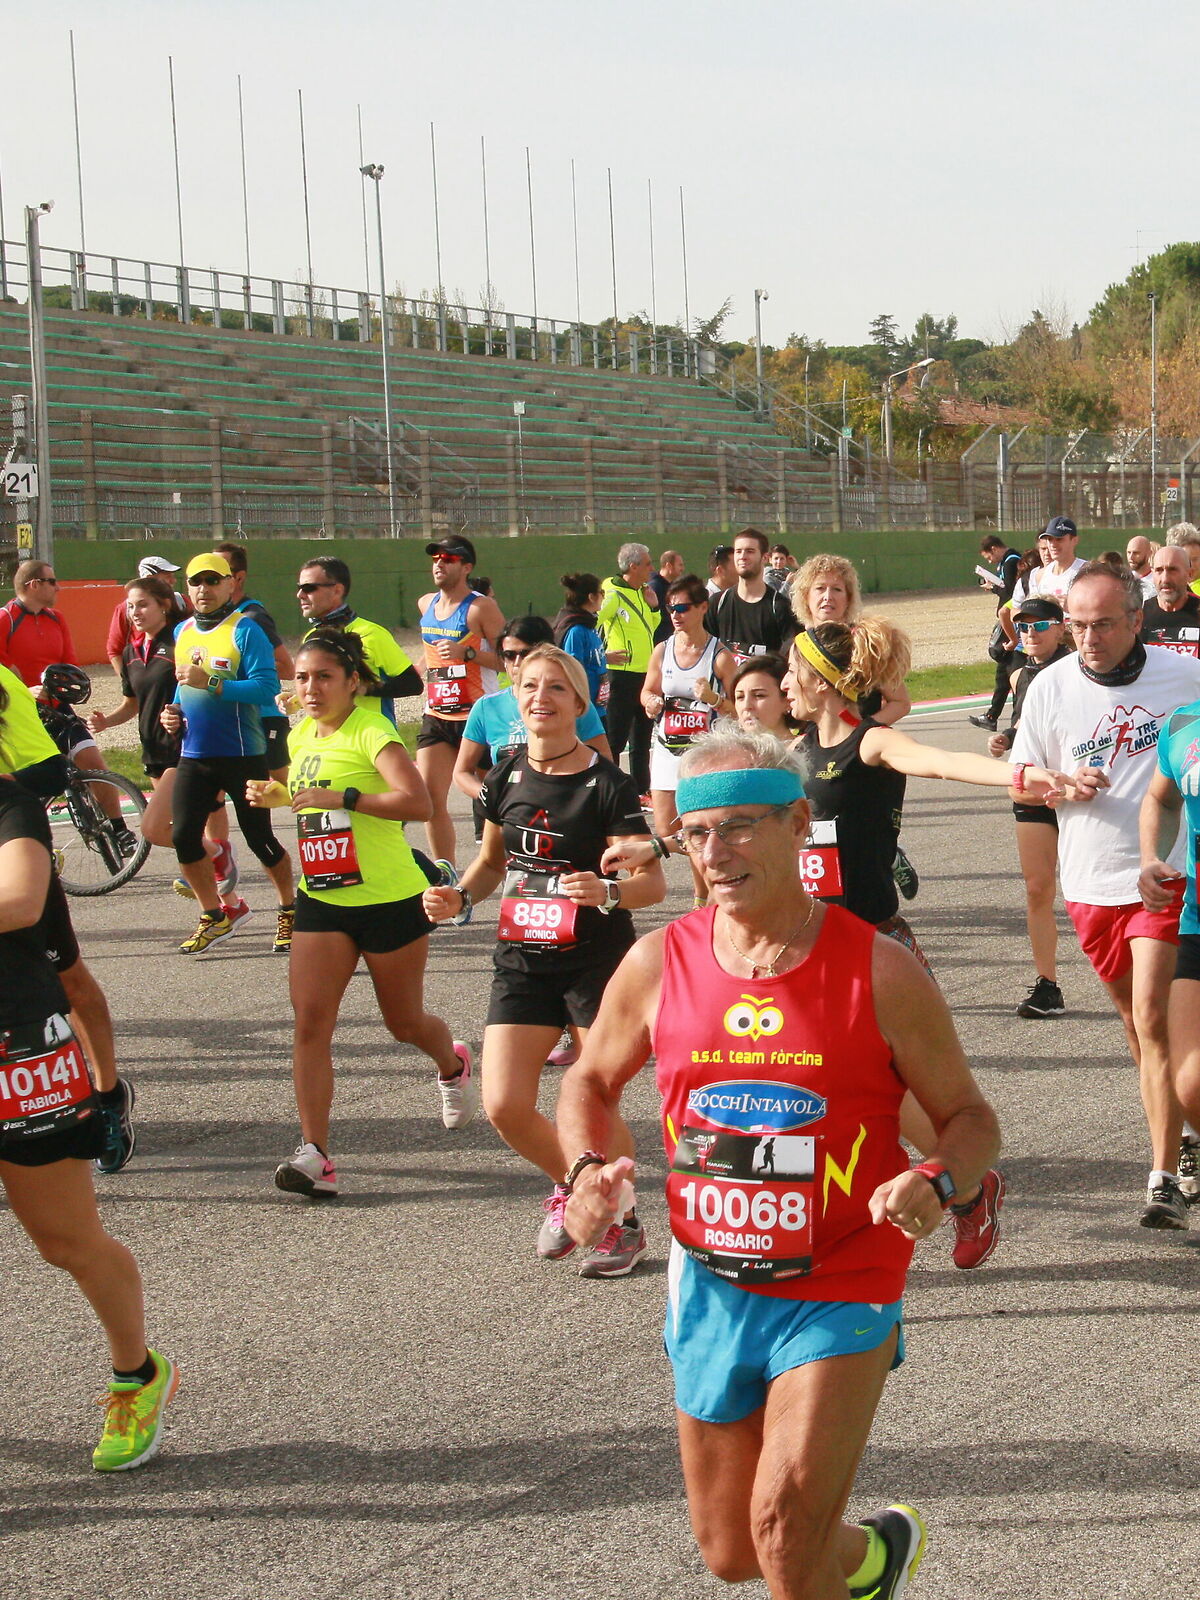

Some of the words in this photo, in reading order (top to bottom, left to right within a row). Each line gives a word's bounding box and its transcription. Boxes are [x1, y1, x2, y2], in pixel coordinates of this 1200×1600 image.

[434, 682, 461, 697] 754
[668, 714, 705, 728] 10184
[1136, 720, 1158, 736] TRE
[1072, 740, 1095, 757] GIRO
[1098, 733, 1113, 747] dei
[1134, 730, 1161, 751] MON
[296, 755, 321, 779] SO
[302, 837, 349, 862] 10197
[513, 902, 562, 928] 859
[524, 928, 558, 940] MONICA
[691, 1050, 724, 1063] a.s.d.
[729, 1050, 765, 1064] team
[0, 1051, 80, 1100] 10141
[20, 1088, 72, 1112] FABIOLA
[689, 1091, 827, 1115] ZOCCHINTAVOLA
[680, 1181, 807, 1231] 10068
[704, 1229, 774, 1250] ROSARIO
[741, 1261, 774, 1269] POLAR
